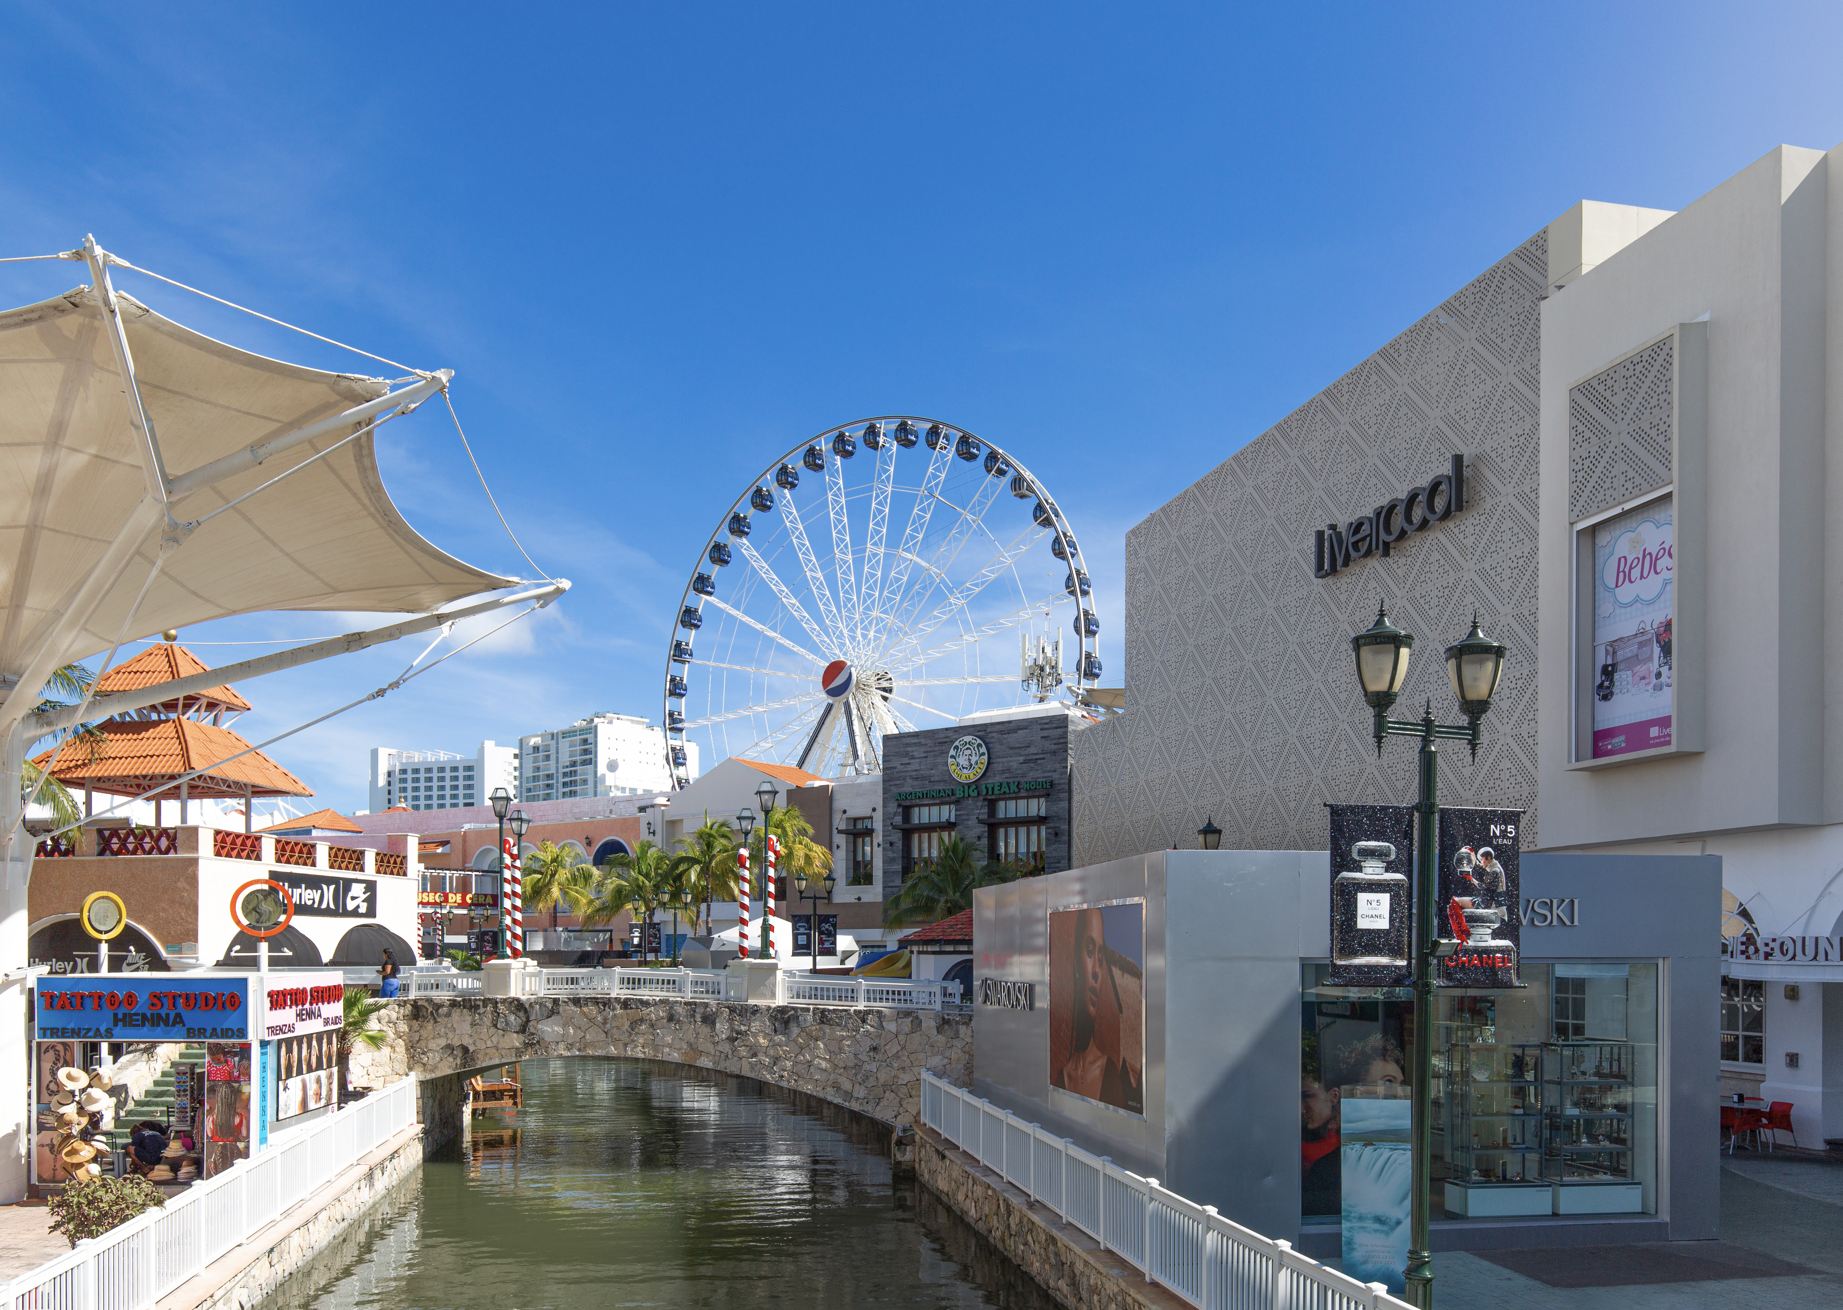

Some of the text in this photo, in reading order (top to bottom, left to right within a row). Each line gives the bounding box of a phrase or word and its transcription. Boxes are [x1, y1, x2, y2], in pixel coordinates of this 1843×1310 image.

[1315, 453, 1464, 578] Liverpool
[895, 780, 1052, 801] ARGENTINIAN BIG STEAK HOUSE
[448, 892, 462, 903] DE
[465, 893, 493, 905] CERA
[1445, 953, 1513, 968] CHANEL
[40, 990, 241, 1011] TATTOO STUDIO
[267, 983, 344, 1011] TATTOO STUDIO
[986, 979, 1030, 1011] SWAROVSKI
[112, 1012, 186, 1027] HENNA
[295, 1006, 322, 1022] HENNA
[40, 1027, 246, 1039] TRENZAS BRAIDS
[266, 1015, 342, 1037] TRENZAS BRAIDS
